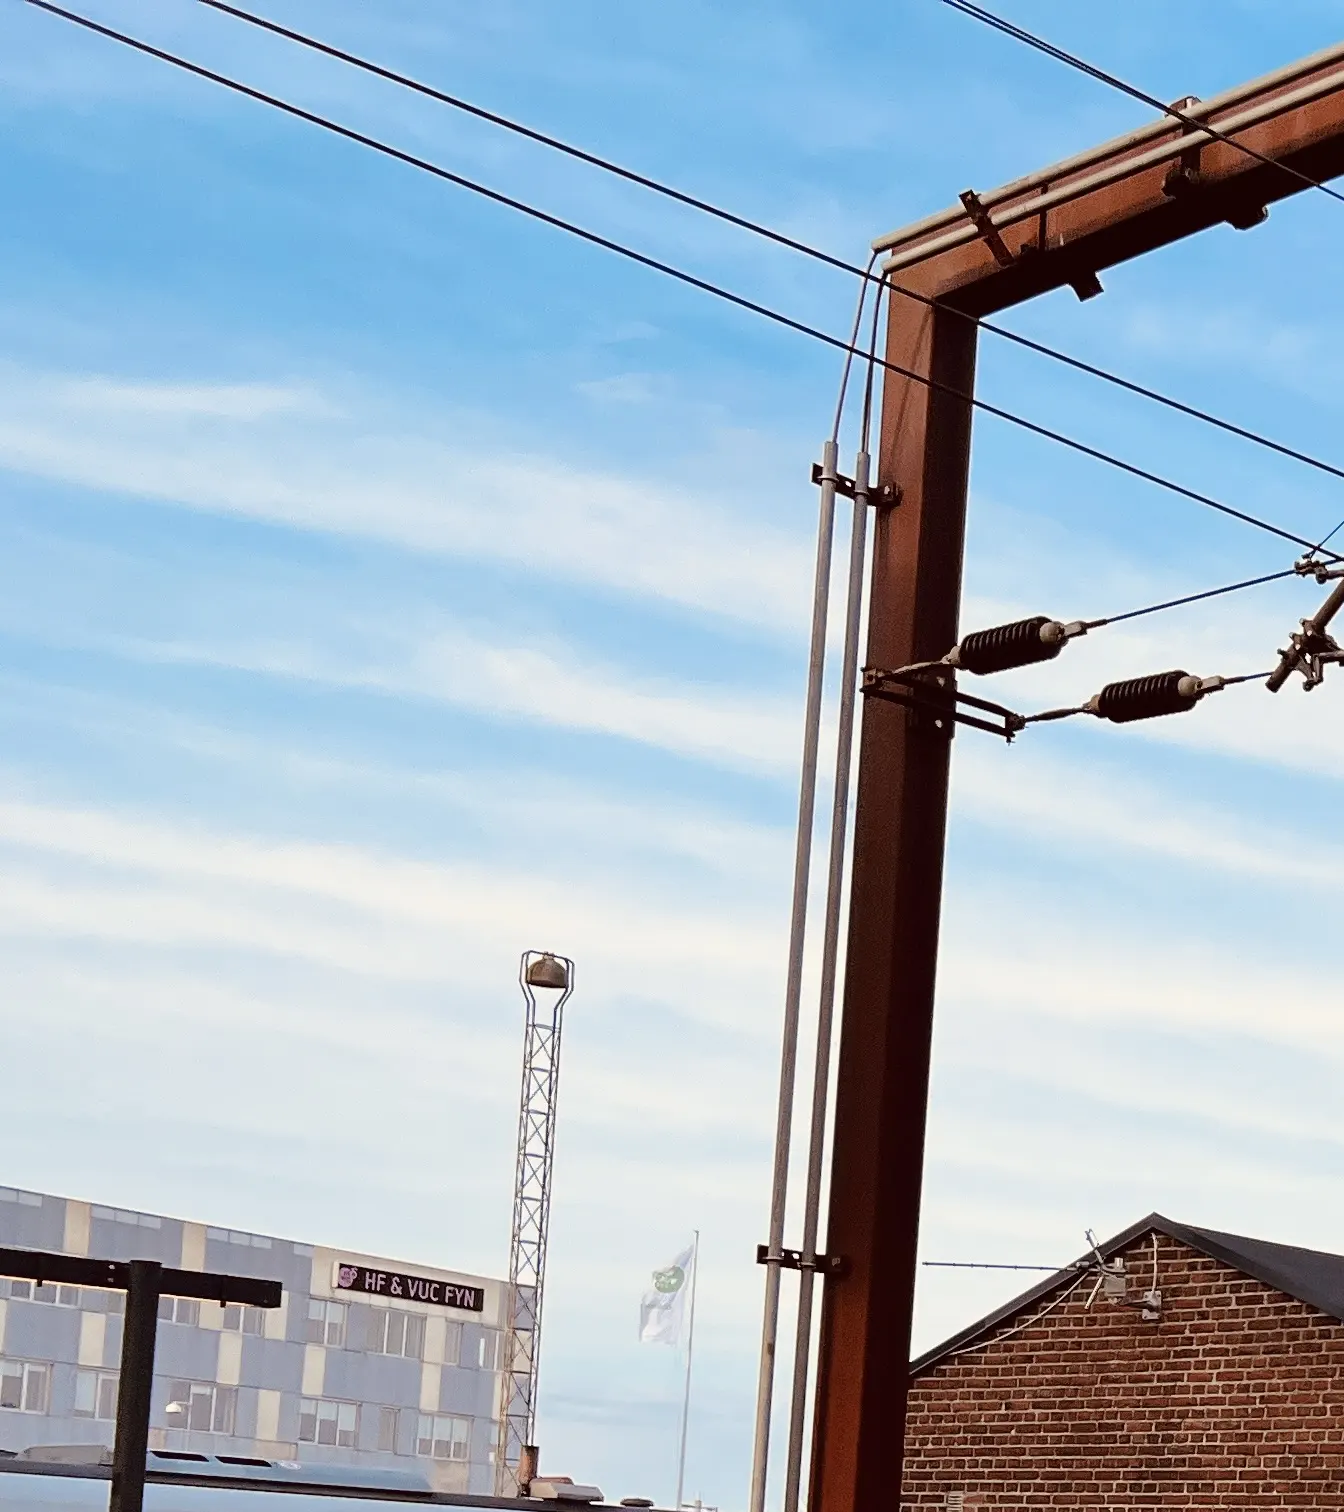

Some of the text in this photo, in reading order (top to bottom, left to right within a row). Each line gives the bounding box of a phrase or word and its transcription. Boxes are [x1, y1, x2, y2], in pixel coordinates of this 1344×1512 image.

[364, 1271, 475, 1308] HF & VUC FYN
